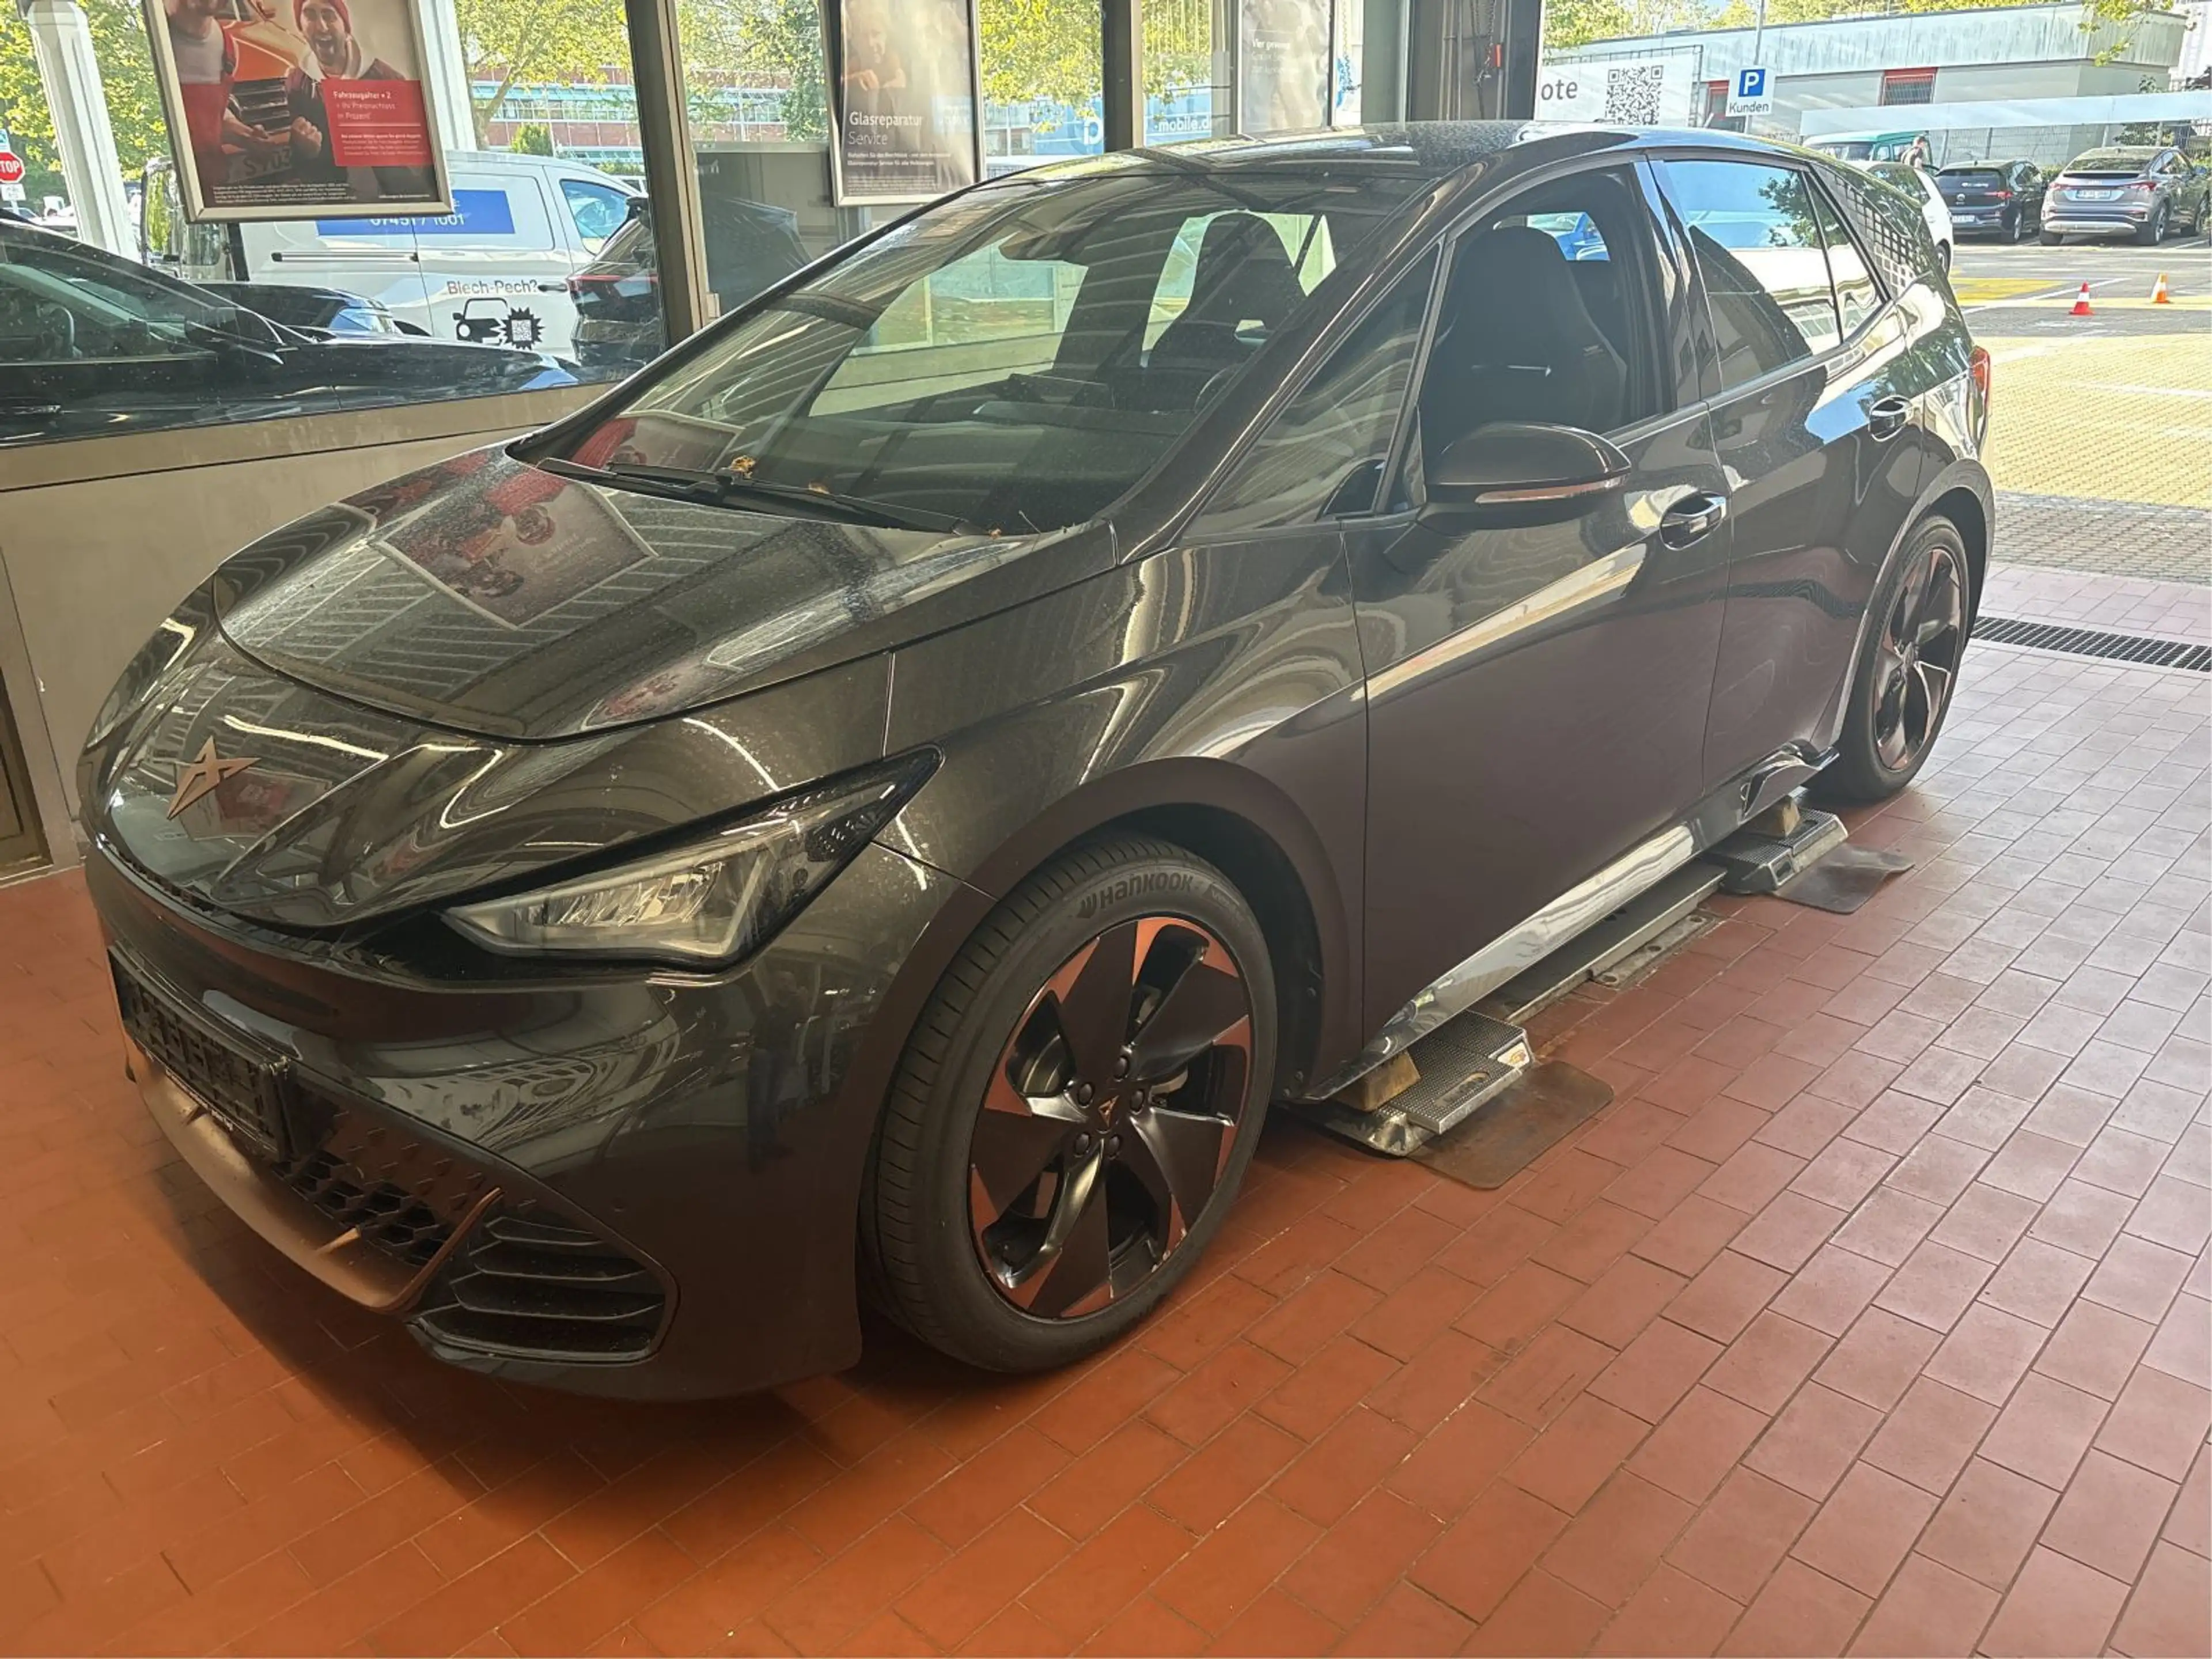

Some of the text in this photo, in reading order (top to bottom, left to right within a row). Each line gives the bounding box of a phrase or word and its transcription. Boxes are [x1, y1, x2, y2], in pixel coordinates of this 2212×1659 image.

[1744, 72, 1759, 95] P
[1729, 102, 1769, 113] Kunden
[849, 112, 923, 128] Glasreparatur
[848, 132, 888, 145] Service
[0, 160, 20, 173] TOP
[447, 279, 537, 294] Blech-Pech?
